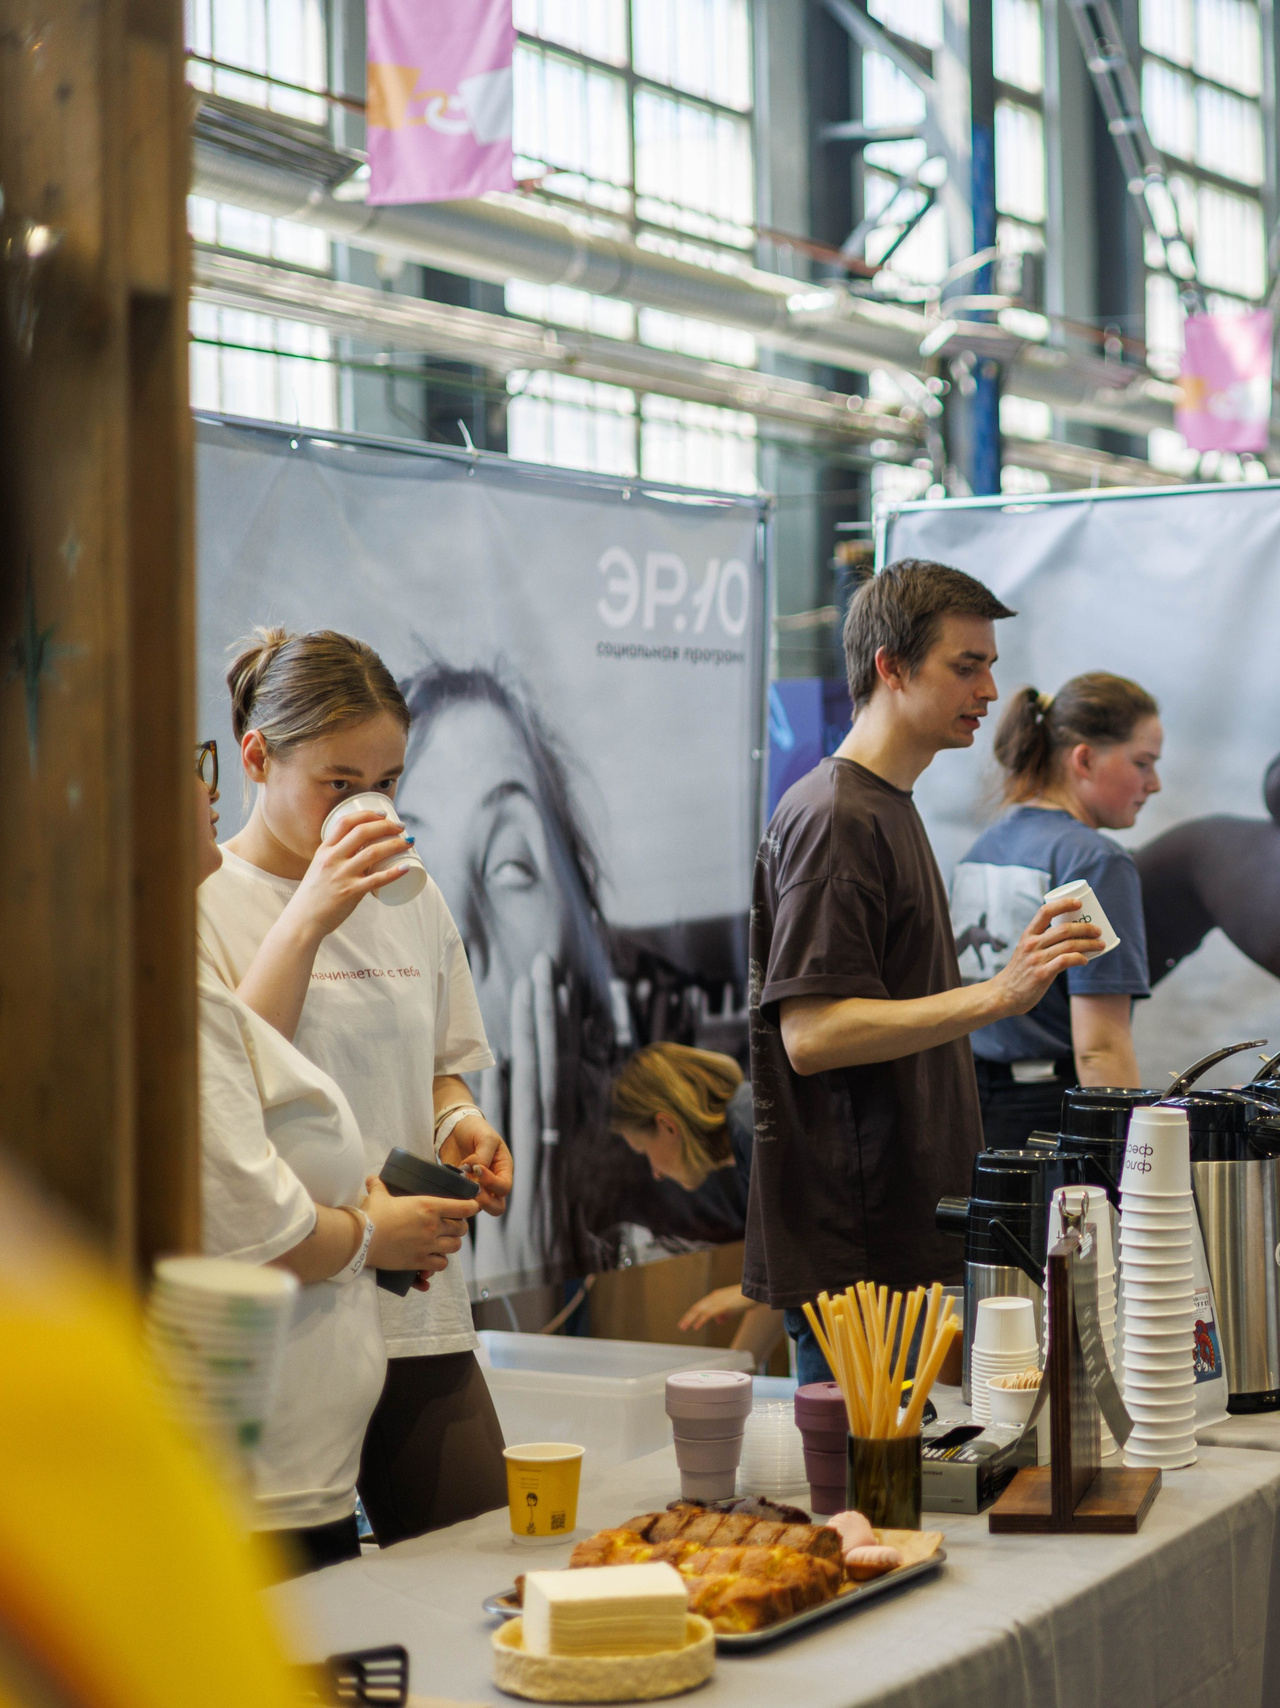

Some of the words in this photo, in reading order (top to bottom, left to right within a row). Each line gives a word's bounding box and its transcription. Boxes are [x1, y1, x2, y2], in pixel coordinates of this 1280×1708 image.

[311, 968, 384, 980] начинается
[387, 969, 396, 978] с
[397, 965, 421, 978] тебя
